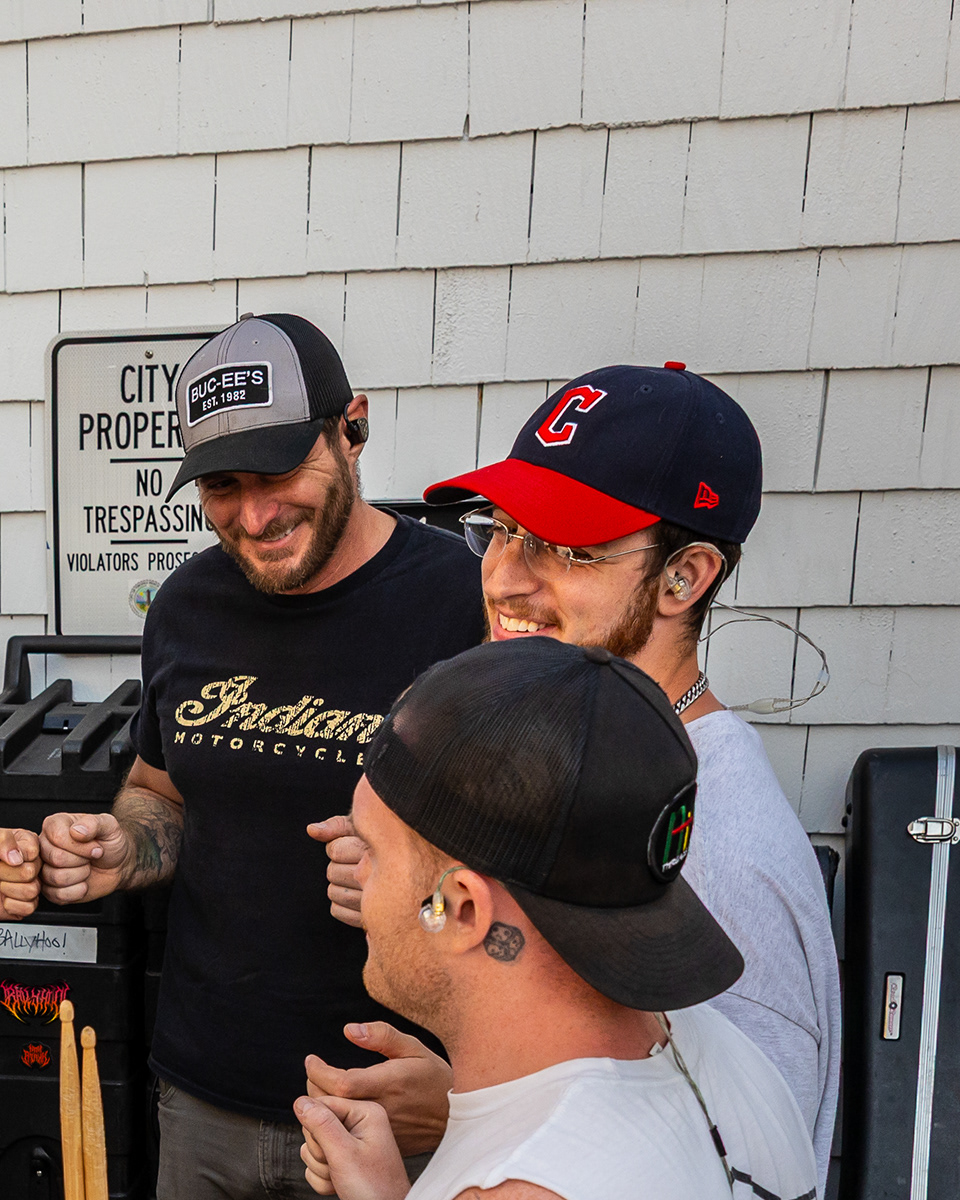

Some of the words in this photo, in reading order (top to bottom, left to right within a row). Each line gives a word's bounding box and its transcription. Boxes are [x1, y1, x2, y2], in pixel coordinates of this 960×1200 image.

[120, 363, 180, 404] CITY
[190, 370, 264, 404] BUC-EE'S
[201, 396, 219, 412] EST.
[220, 389, 246, 404] 1982
[534, 384, 608, 448] C
[136, 468, 163, 497] NO
[67, 551, 140, 572] VIOLATORS
[174, 675, 385, 744] Indian
